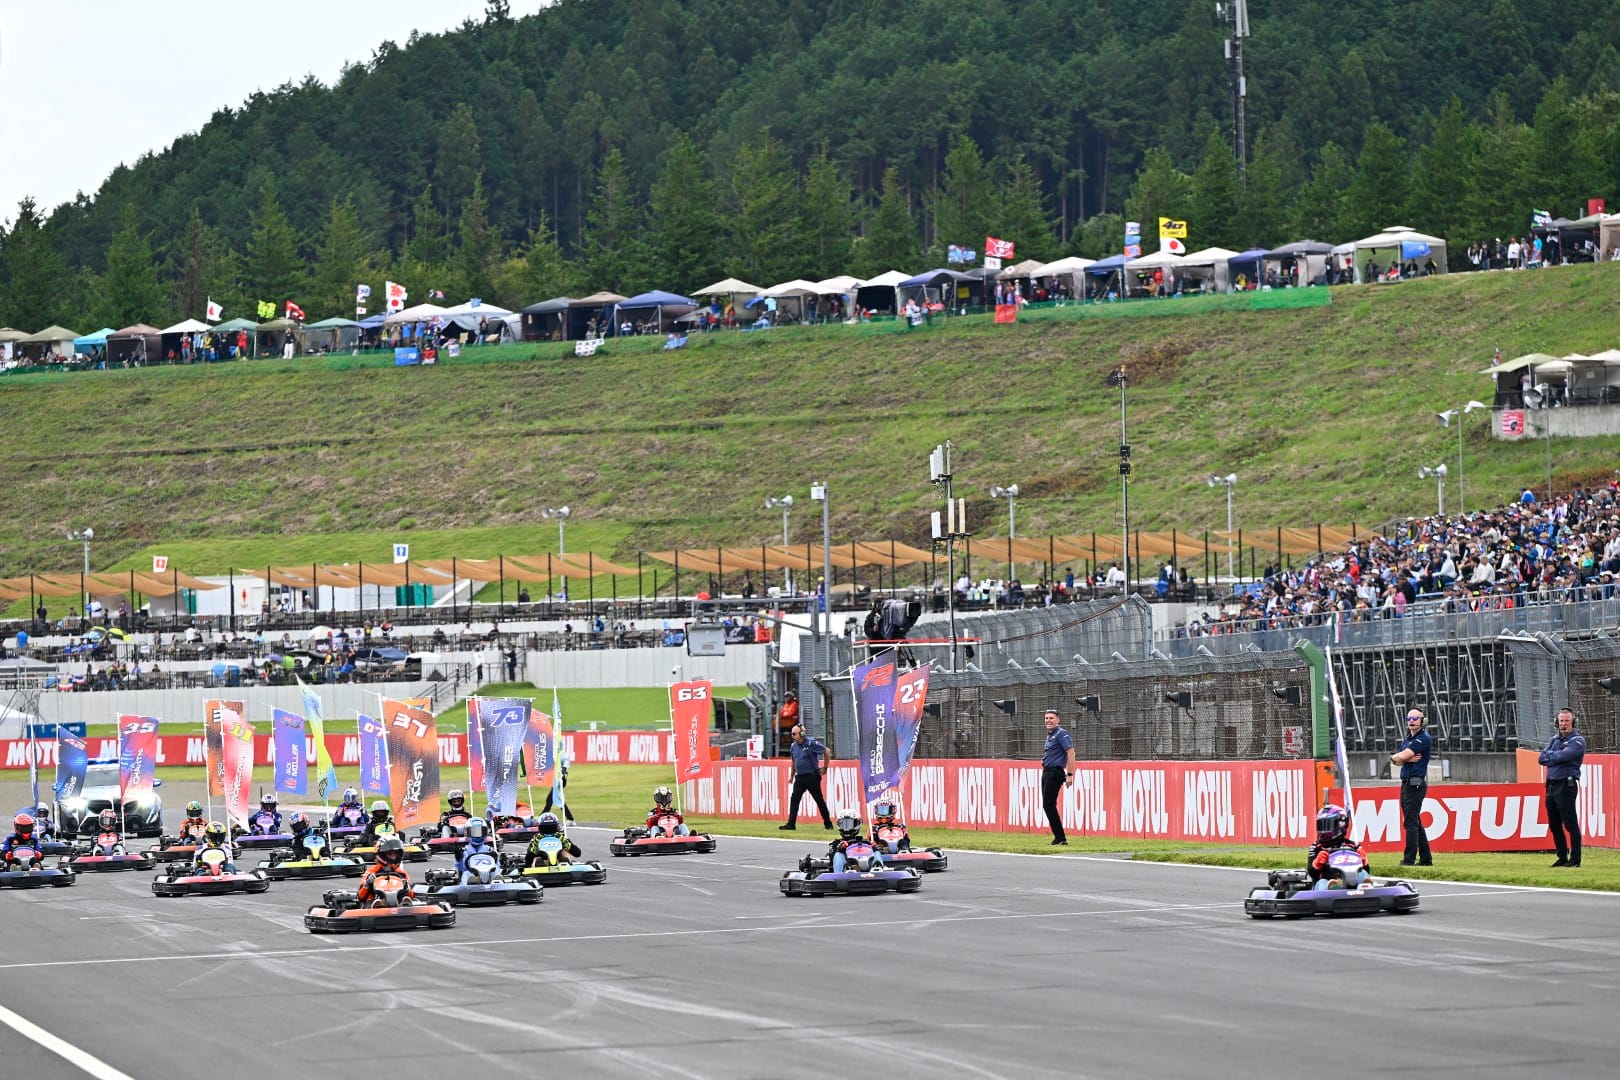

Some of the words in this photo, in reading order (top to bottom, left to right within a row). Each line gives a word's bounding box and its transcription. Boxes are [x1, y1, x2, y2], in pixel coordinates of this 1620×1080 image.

[678, 687, 707, 702] 63
[124, 723, 156, 735] 35
[393, 711, 429, 738] 37
[587, 734, 620, 762] MOTUL
[629, 734, 660, 762] MOTUL
[720, 766, 744, 815] MOTUL
[751, 766, 780, 816] MOTUL
[911, 766, 947, 822] MOTUL
[957, 766, 997, 825] MOTUL
[1062, 768, 1107, 832] MOTUL
[1120, 768, 1169, 834] MOTUL
[1183, 769, 1235, 838] MOTUL
[1252, 768, 1308, 840] MOTUL
[1575, 764, 1606, 838] TUL
[1352, 795, 1550, 843] MOTUL
